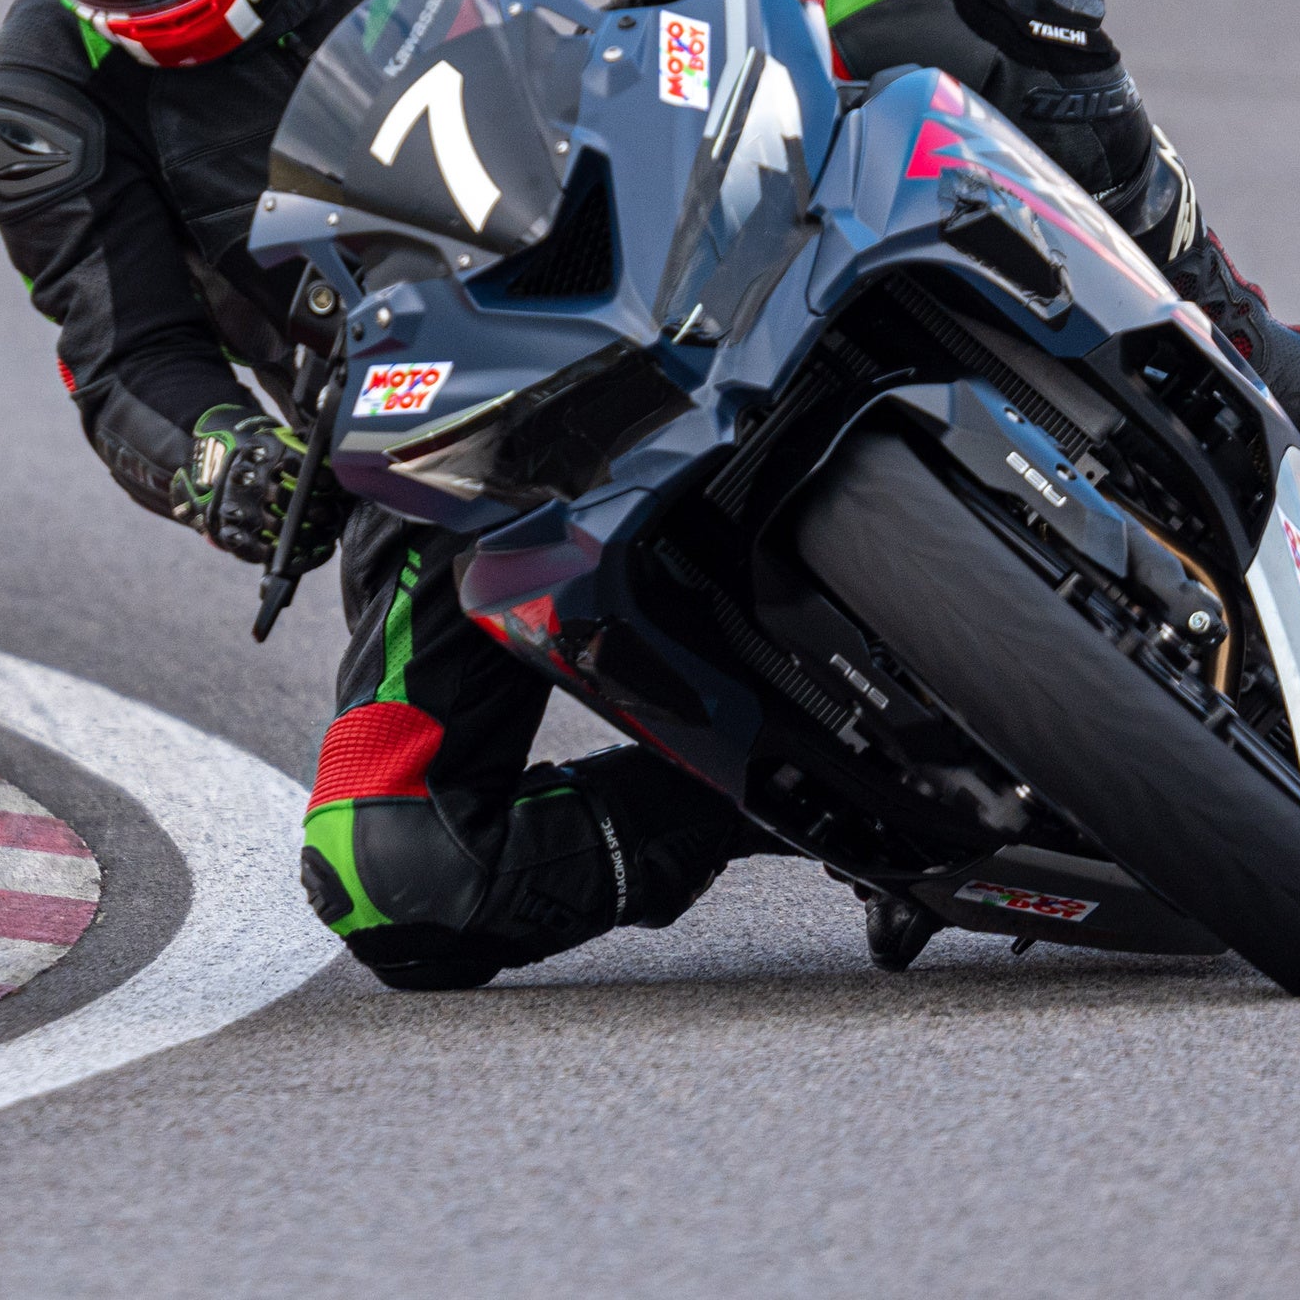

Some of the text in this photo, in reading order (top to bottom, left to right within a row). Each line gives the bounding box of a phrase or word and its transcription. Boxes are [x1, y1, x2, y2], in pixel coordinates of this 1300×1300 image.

[1029, 20, 1087, 46] TAICHI
[667, 21, 686, 98] MOTO
[689, 25, 705, 71] BOY
[369, 59, 502, 234] 7
[367, 368, 440, 390] MOTO
[384, 390, 429, 410] BOY
[611, 850, 627, 894] RACING
[972, 882, 1086, 911] MOTO
[1006, 898, 1082, 918] BOY
